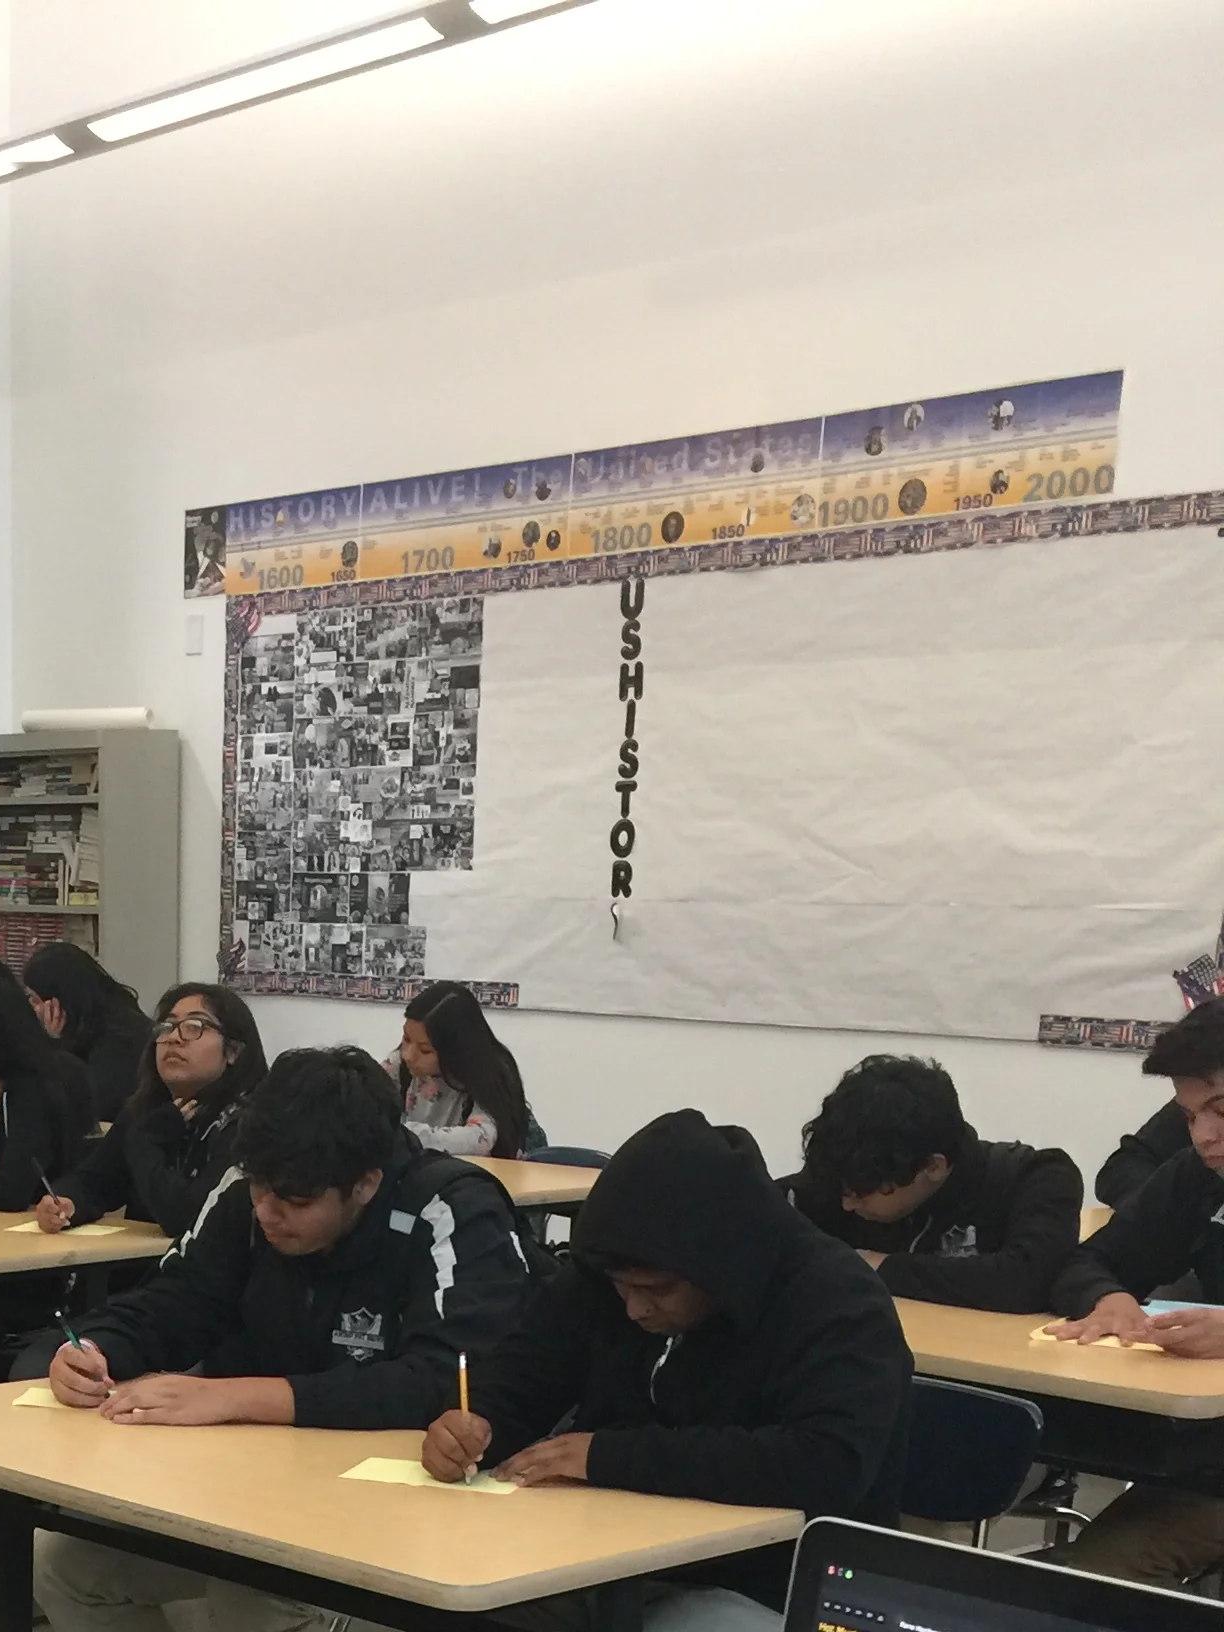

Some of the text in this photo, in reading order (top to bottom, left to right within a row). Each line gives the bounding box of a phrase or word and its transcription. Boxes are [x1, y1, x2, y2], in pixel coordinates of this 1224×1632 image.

[228, 489, 357, 533] HISTORY
[512, 466, 562, 494] The
[587, 441, 690, 483] Unied
[1024, 464, 1116, 502] 2000
[818, 492, 889, 527] 1900
[953, 492, 993, 511] 1950
[589, 521, 653, 553] 1800
[711, 523, 745, 540] 1850
[401, 546, 455, 574] 1700
[506, 548, 535, 564] 1750
[258, 564, 304, 591] 1600
[331, 569, 356, 583] 1650
